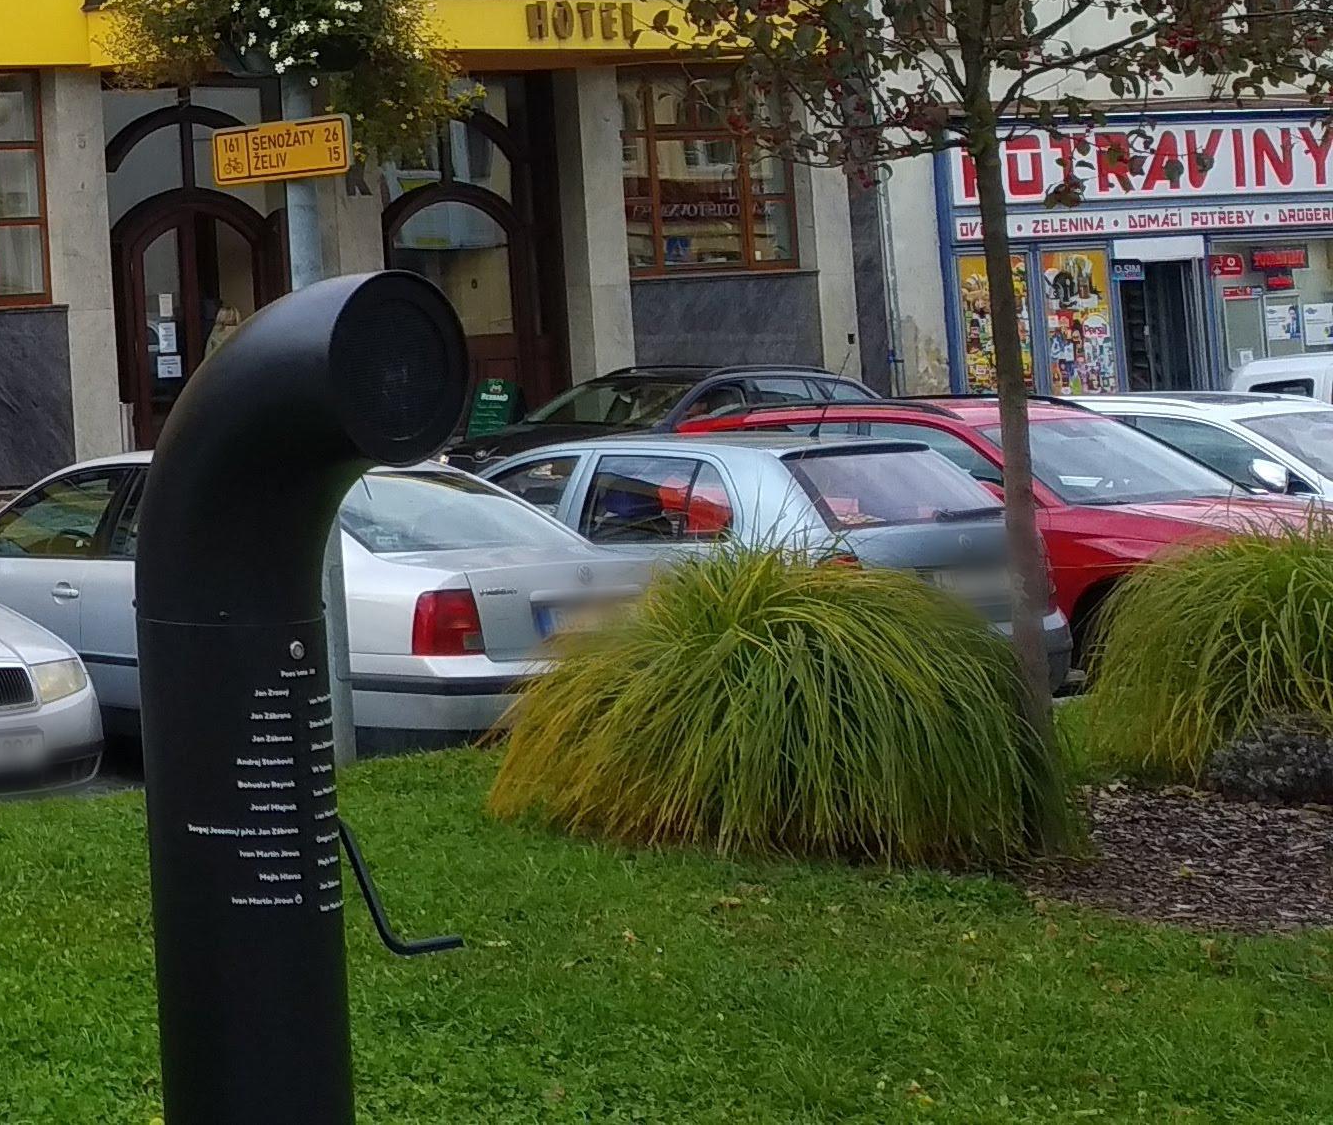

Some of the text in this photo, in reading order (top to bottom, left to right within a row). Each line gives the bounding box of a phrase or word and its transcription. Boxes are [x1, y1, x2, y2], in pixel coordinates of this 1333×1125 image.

[525, 0, 634, 41] HOTEL
[223, 137, 241, 154] 161
[251, 126, 340, 151] SENOŽATY 26
[253, 146, 341, 171] ŽELIV 15
[1032, 216, 1105, 234] ZELENINA
[1128, 208, 1182, 229] DOMÁCÍ
[1191, 206, 1256, 226] POTŘEBY
[1084, 323, 1108, 338] Persil
[239, 850, 255, 858] Ivan
[256, 850, 280, 858] Martin
[231, 896, 248, 905] Ivan
[249, 896, 273, 905] Martin
